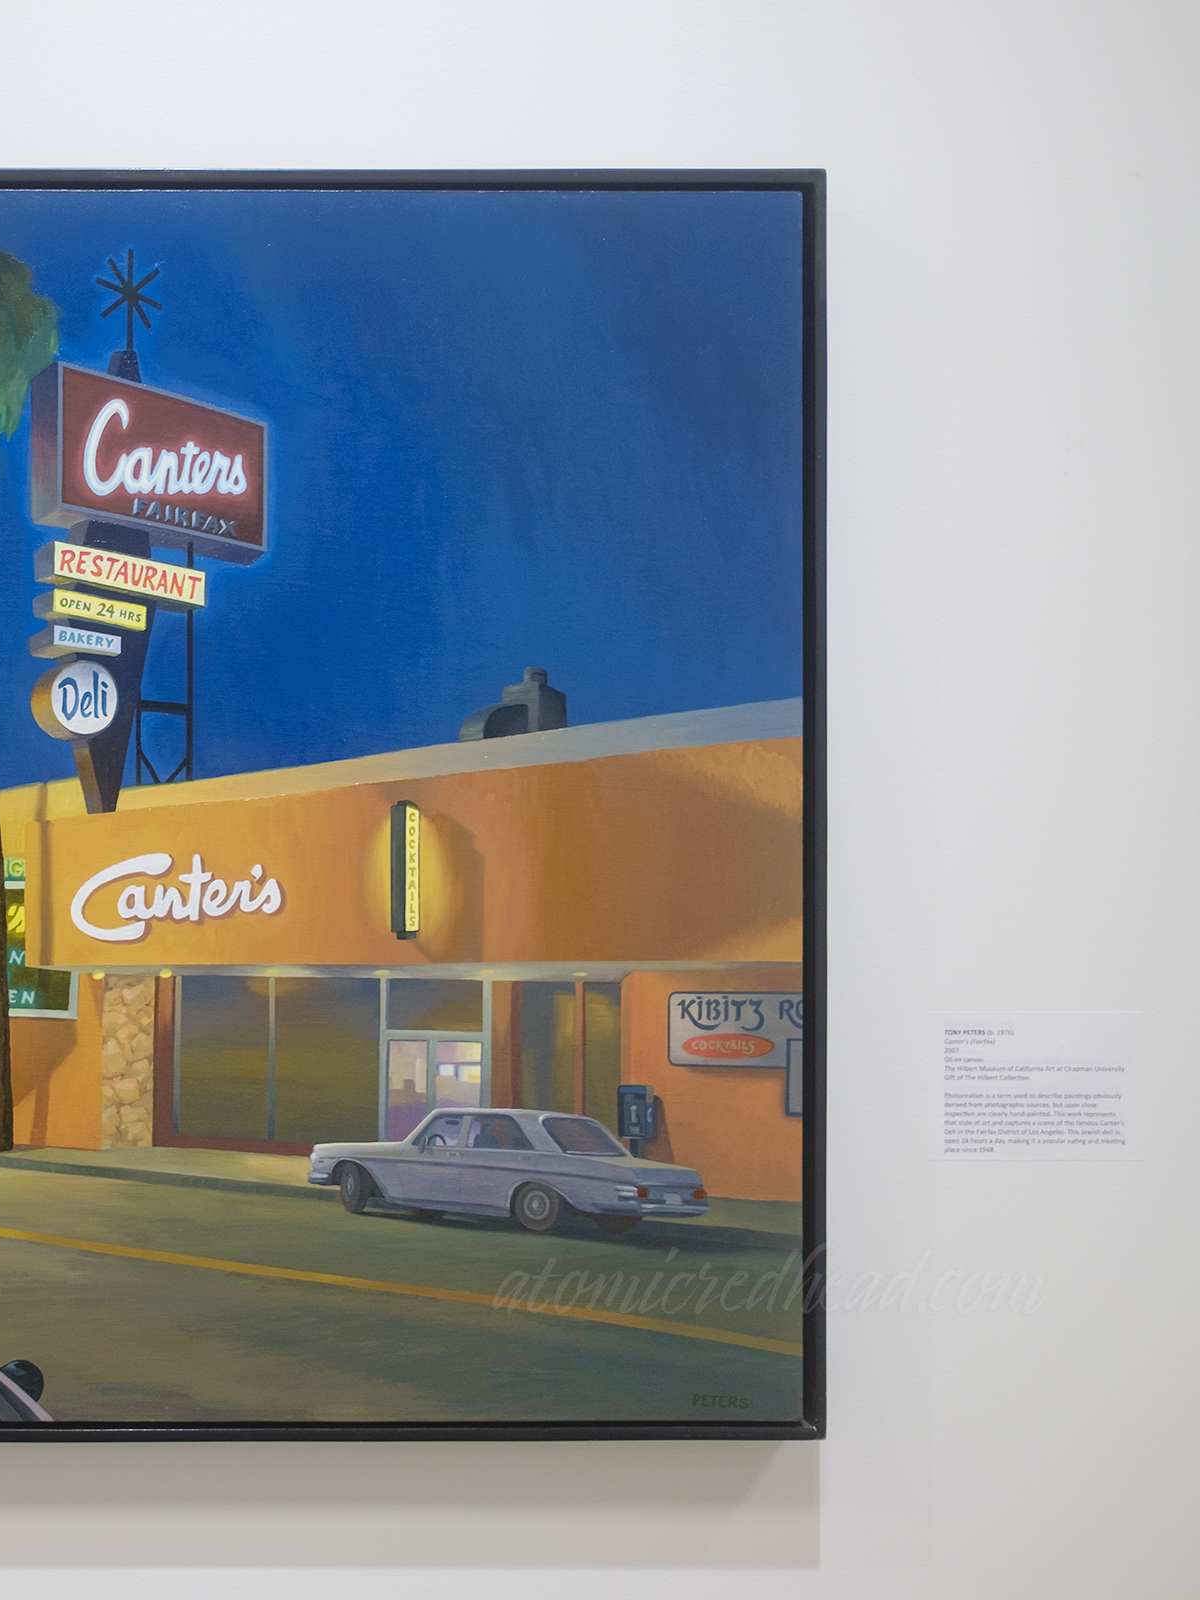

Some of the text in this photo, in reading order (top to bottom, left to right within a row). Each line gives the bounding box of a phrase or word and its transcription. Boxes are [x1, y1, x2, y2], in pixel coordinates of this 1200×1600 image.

[83, 398, 247, 496] Canters
[132, 497, 238, 538] FAIRFAX
[59, 548, 202, 600] RESTAURANT
[59, 597, 142, 623] OPEN 24 HRS
[58, 630, 115, 648] BAKERY
[57, 670, 109, 721] Deli
[407, 812, 418, 928] COCKTAILS
[70, 852, 282, 942] Canter's
[986, 1029, 995, 1037] (b.
[691, 1039, 755, 1055] COCKTAILS
[970, 1038, 996, 1046] (Fairfax)
[1063, 1066, 1093, 1074] Chapman
[1094, 1066, 1125, 1074] University
[1064, 1093, 1092, 1101] paintings
[1093, 1093, 1122, 1101] obviously
[984, 1102, 1025, 1110] photographic
[1064, 1102, 1080, 1110] upon
[944, 1111, 976, 1119] inspection
[988, 1111, 1008, 1119] clearly
[1009, 1111, 1052, 1119] hand-painted.
[1083, 1111, 1116, 1119] represents
[958, 1119, 973, 1127] style
[1004, 1120, 1031, 1128] captures
[1040, 1129, 1065, 1137] Angeles.
[944, 1138, 960, 1146] open
[994, 1138, 1006, 1146] day,
[1007, 1138, 1030, 1146] making
[1042, 1138, 1066, 1146] popular
[1067, 1138, 1086, 1146] eating
[1100, 1138, 1126, 1146] meeting
[944, 1147, 961, 1155] place
[692, 1393, 749, 1411] PETERS
